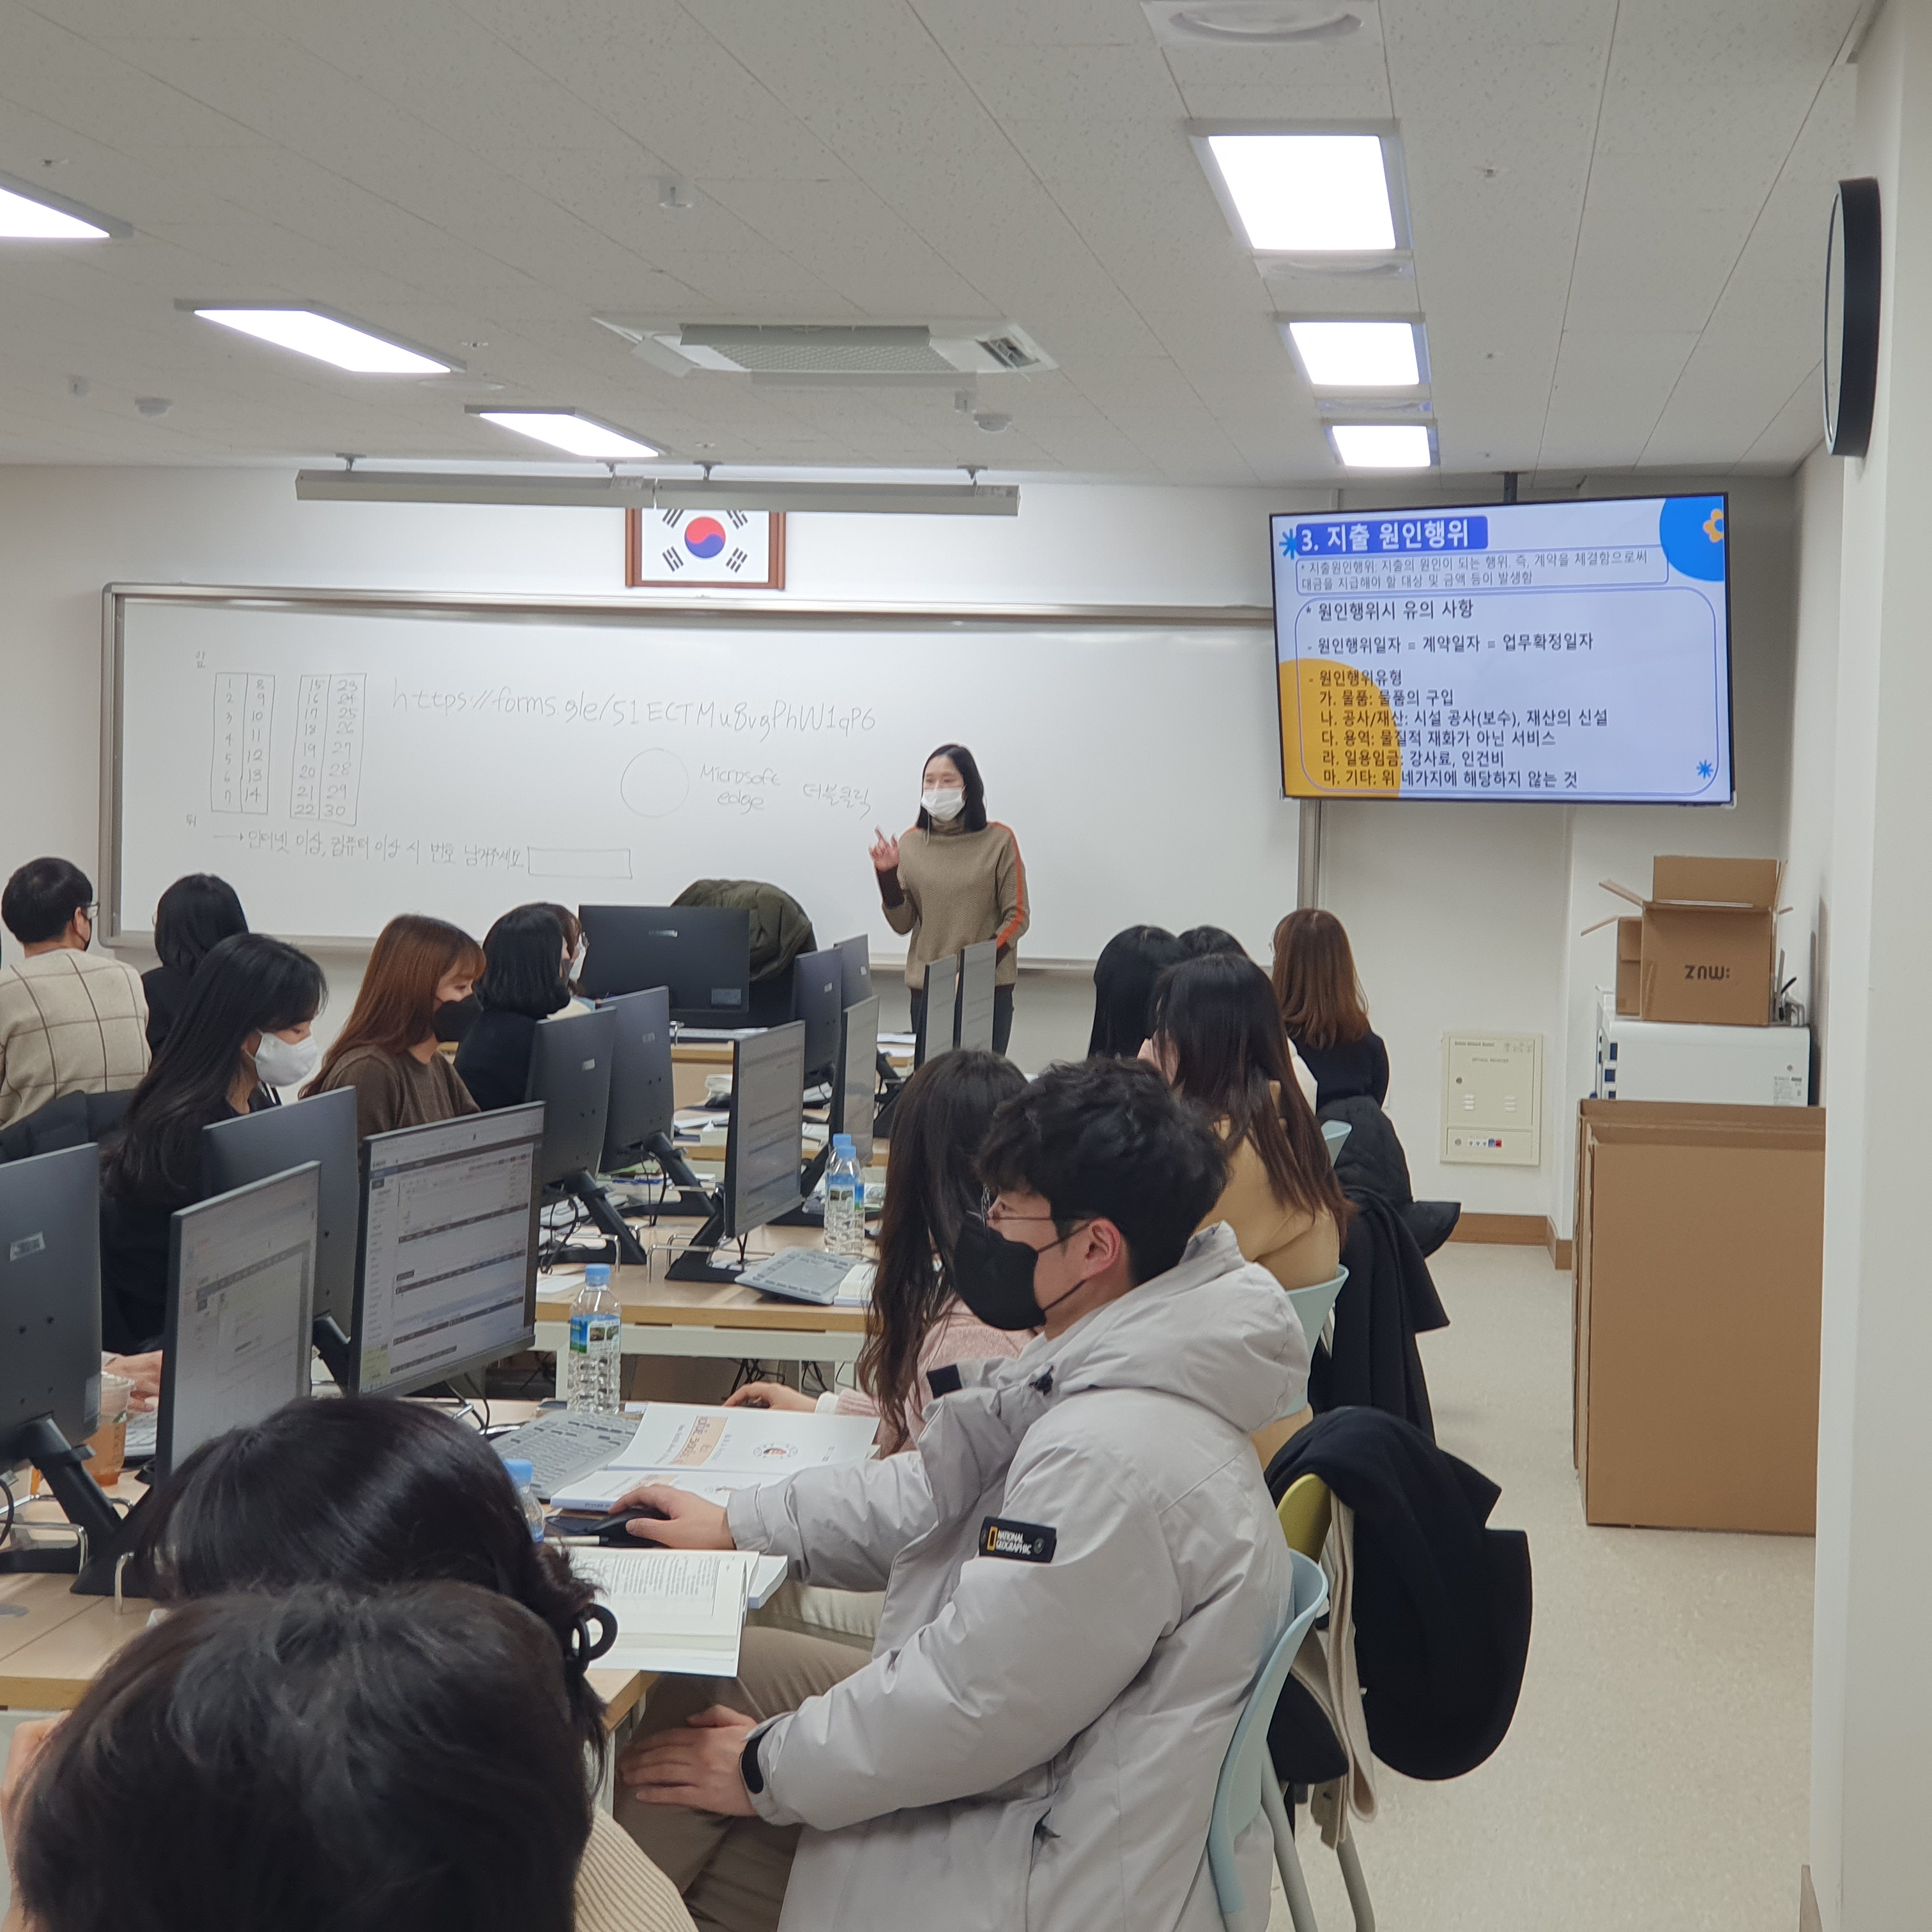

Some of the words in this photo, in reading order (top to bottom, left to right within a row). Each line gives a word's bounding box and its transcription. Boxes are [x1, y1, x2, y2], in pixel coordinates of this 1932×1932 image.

[1301, 529, 1319, 551] 3.
[1328, 523, 1370, 553] 지출
[1379, 519, 1468, 549] 원인행위
[1310, 560, 1377, 575] 지출원인행위:
[1382, 558, 1414, 574] 지출의
[1420, 557, 1453, 572] 원인이
[1458, 556, 1480, 570] 되는
[1534, 551, 1568, 567] 계약을
[1574, 549, 1647, 567] 체결함으로써
[1301, 576, 1333, 591] 대금을
[1338, 575, 1381, 590] 지급해야
[1386, 576, 1396, 589] 할
[1402, 574, 1423, 588] 대상
[1429, 574, 1438, 587] 및
[1444, 572, 1466, 587] 금액
[1471, 571, 1493, 586] 등이
[1498, 570, 1532, 586] 발생함
[1319, 601, 1395, 622] 원인행위시
[1404, 599, 1434, 620] 유의
[1441, 598, 1473, 619] 사항
[1318, 635, 1401, 655] 원인행위일자
[1423, 634, 1480, 653] 계약일자
[1503, 632, 1593, 652] 업무확정일자
[257, 679, 264, 690] 8
[310, 678, 326, 691] 15
[1319, 669, 1402, 687] 원인행위유형
[226, 693, 234, 703] 2
[257, 693, 265, 706] 9
[307, 693, 319, 704] 16
[1320, 689, 1337, 707] 가.
[1342, 689, 1372, 707] 물품:
[1379, 689, 1420, 707] 물품의
[1426, 689, 1453, 707] 구입
[252, 710, 263, 721] 10
[305, 708, 318, 719] 17
[1321, 709, 1337, 726] 나.
[1342, 709, 1408, 728] 공사/재산:
[1414, 709, 1441, 727] 시설
[1448, 709, 1521, 728] 공사(보수),
[1527, 709, 1571, 727] 재산의
[1579, 708, 1607, 726] 신설
[252, 729, 261, 742] 11
[336, 721, 354, 735] 26
[1322, 730, 1338, 747] 다.
[1344, 730, 1374, 747] 용역:
[1380, 729, 1421, 747] 물질적
[1428, 729, 1470, 747] 재화가
[1476, 730, 1505, 747] 아닌
[1512, 730, 1556, 747] 서비스
[247, 749, 263, 762] 12
[303, 742, 316, 758] 19
[332, 741, 351, 759] 27
[226, 753, 232, 765] 5
[1322, 749, 1339, 767] 라.
[1345, 749, 1404, 767] 일용임금:
[1410, 750, 1455, 768] 강사료,
[1462, 750, 1504, 767] 인건비
[224, 772, 231, 782] 6
[248, 769, 262, 783] 13
[299, 766, 316, 779] 20
[328, 763, 351, 776] 28
[700, 763, 781, 786] Microsoft
[1324, 769, 1340, 786] 마.
[1346, 769, 1376, 786] 기타:
[1382, 769, 1395, 786] 위
[1402, 769, 1457, 787] 네가지에
[1464, 769, 1521, 788] 해당하지
[1528, 770, 1557, 788] 않는
[1565, 770, 1577, 788] 것
[245, 786, 261, 803] 14
[296, 785, 313, 801] 21
[326, 785, 347, 800] 29
[294, 804, 314, 815] 22
[323, 804, 346, 816] 30
[717, 790, 765, 816] edge
[249, 831, 289, 854] 인터넷
[331, 833, 369, 860] 컴퓨터
[375, 834, 401, 861] 이상
[406, 839, 420, 864] 시
[431, 843, 457, 864] 번호
